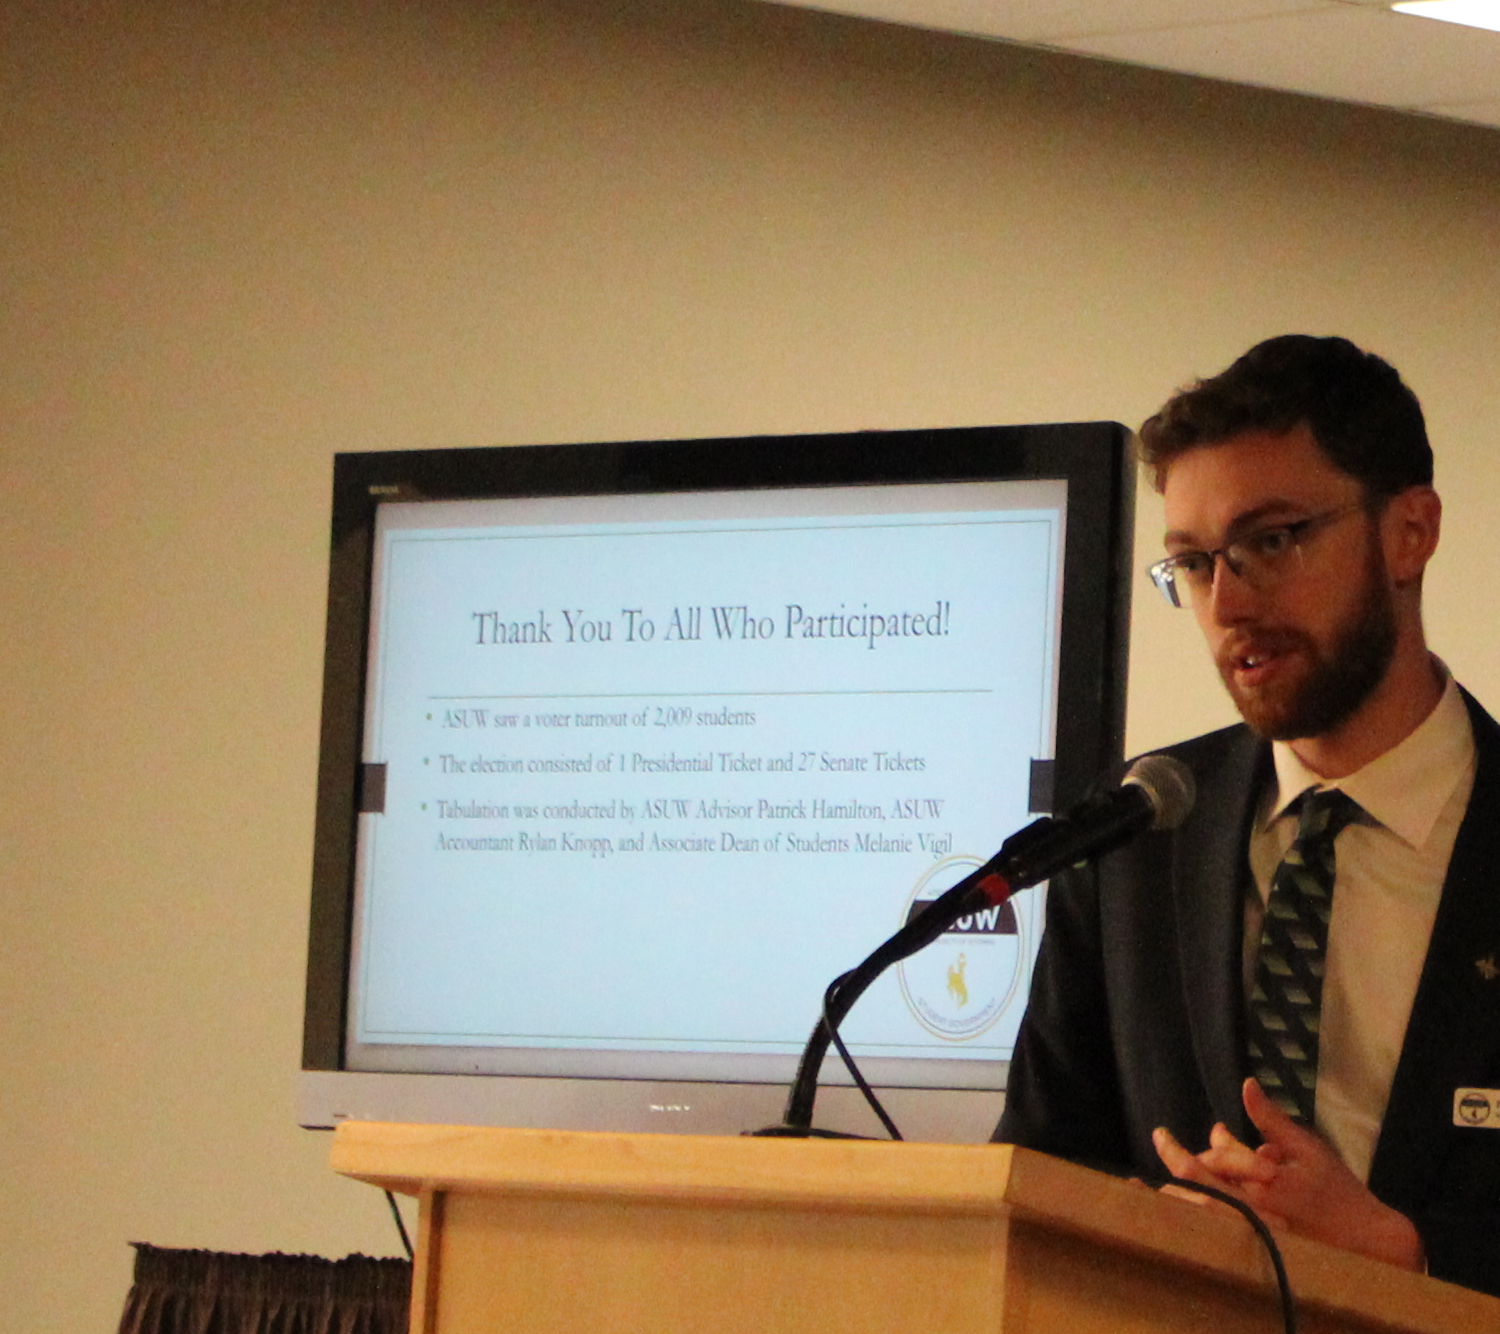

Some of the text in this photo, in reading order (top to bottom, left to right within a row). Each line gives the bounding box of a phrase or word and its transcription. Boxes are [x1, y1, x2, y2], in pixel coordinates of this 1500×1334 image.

[472, 600, 951, 650] Thank You To All Who Participated!
[442, 706, 756, 729] ASUW saw a voter turnout of 2,009 students
[439, 754, 465, 773] The
[470, 753, 524, 773] election
[527, 752, 592, 773] consisted
[598, 752, 614, 773] of
[632, 751, 713, 773] Presidential
[718, 751, 762, 772] Ticket
[767, 751, 794, 772] and
[798, 751, 816, 773] 27
[820, 750, 868, 772] Senate
[873, 750, 926, 772] Tickets
[436, 798, 946, 823] Tabulation was conducted by ASUW Advisor Patrick Hamilton, ASUW
[436, 831, 953, 860] Accountant Rylan Knopp, and Associate Dean of Students Melanie Vigil
